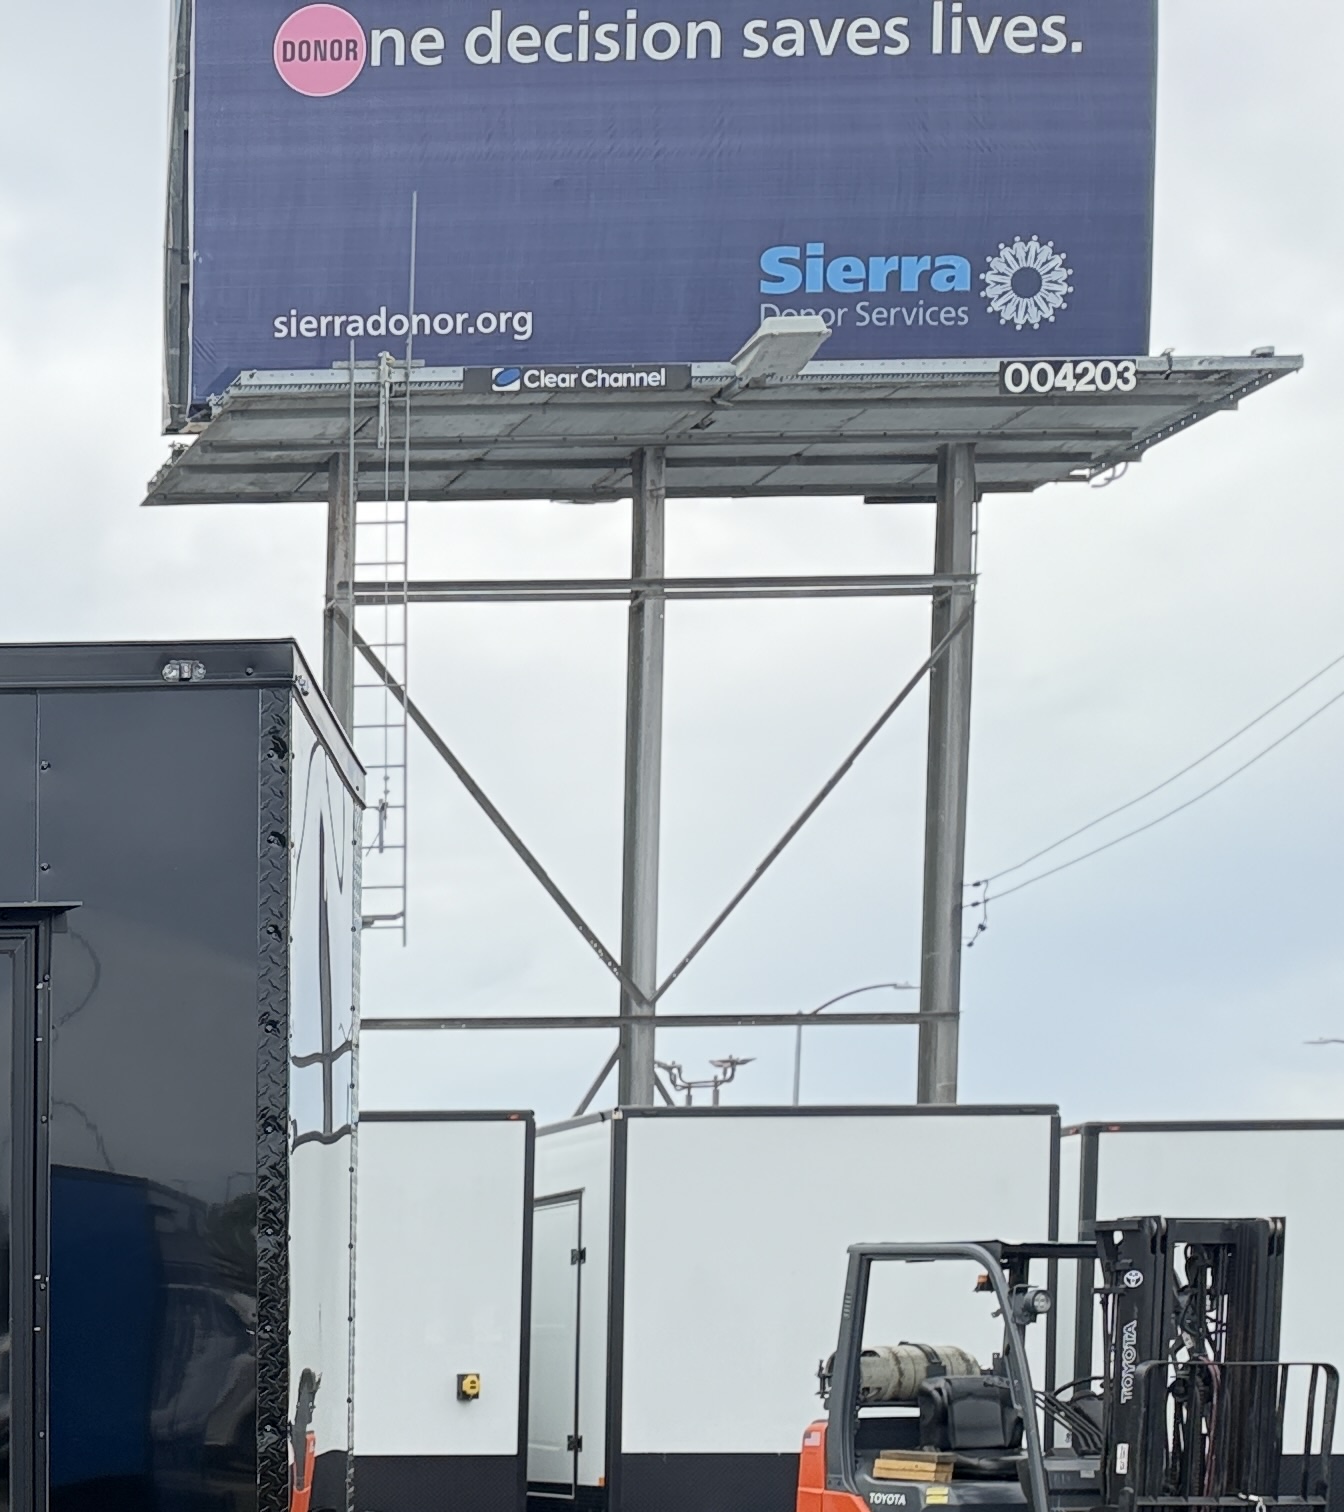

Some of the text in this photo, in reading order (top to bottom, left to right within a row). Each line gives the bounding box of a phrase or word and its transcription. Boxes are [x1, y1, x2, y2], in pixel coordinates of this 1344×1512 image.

[281, 37, 359, 64] DONOR
[463, 8, 724, 65] decision
[741, 14, 911, 59] saves
[930, 0, 1084, 55] lives.
[759, 242, 972, 295] Sierra
[272, 305, 534, 341] sierradonor.org
[855, 299, 970, 328] Services
[522, 366, 667, 390] Clear Channel
[1003, 360, 1138, 394] 004203
[1120, 1319, 1138, 1404] TOYOTA
[868, 1491, 907, 1507] TOYOTA
